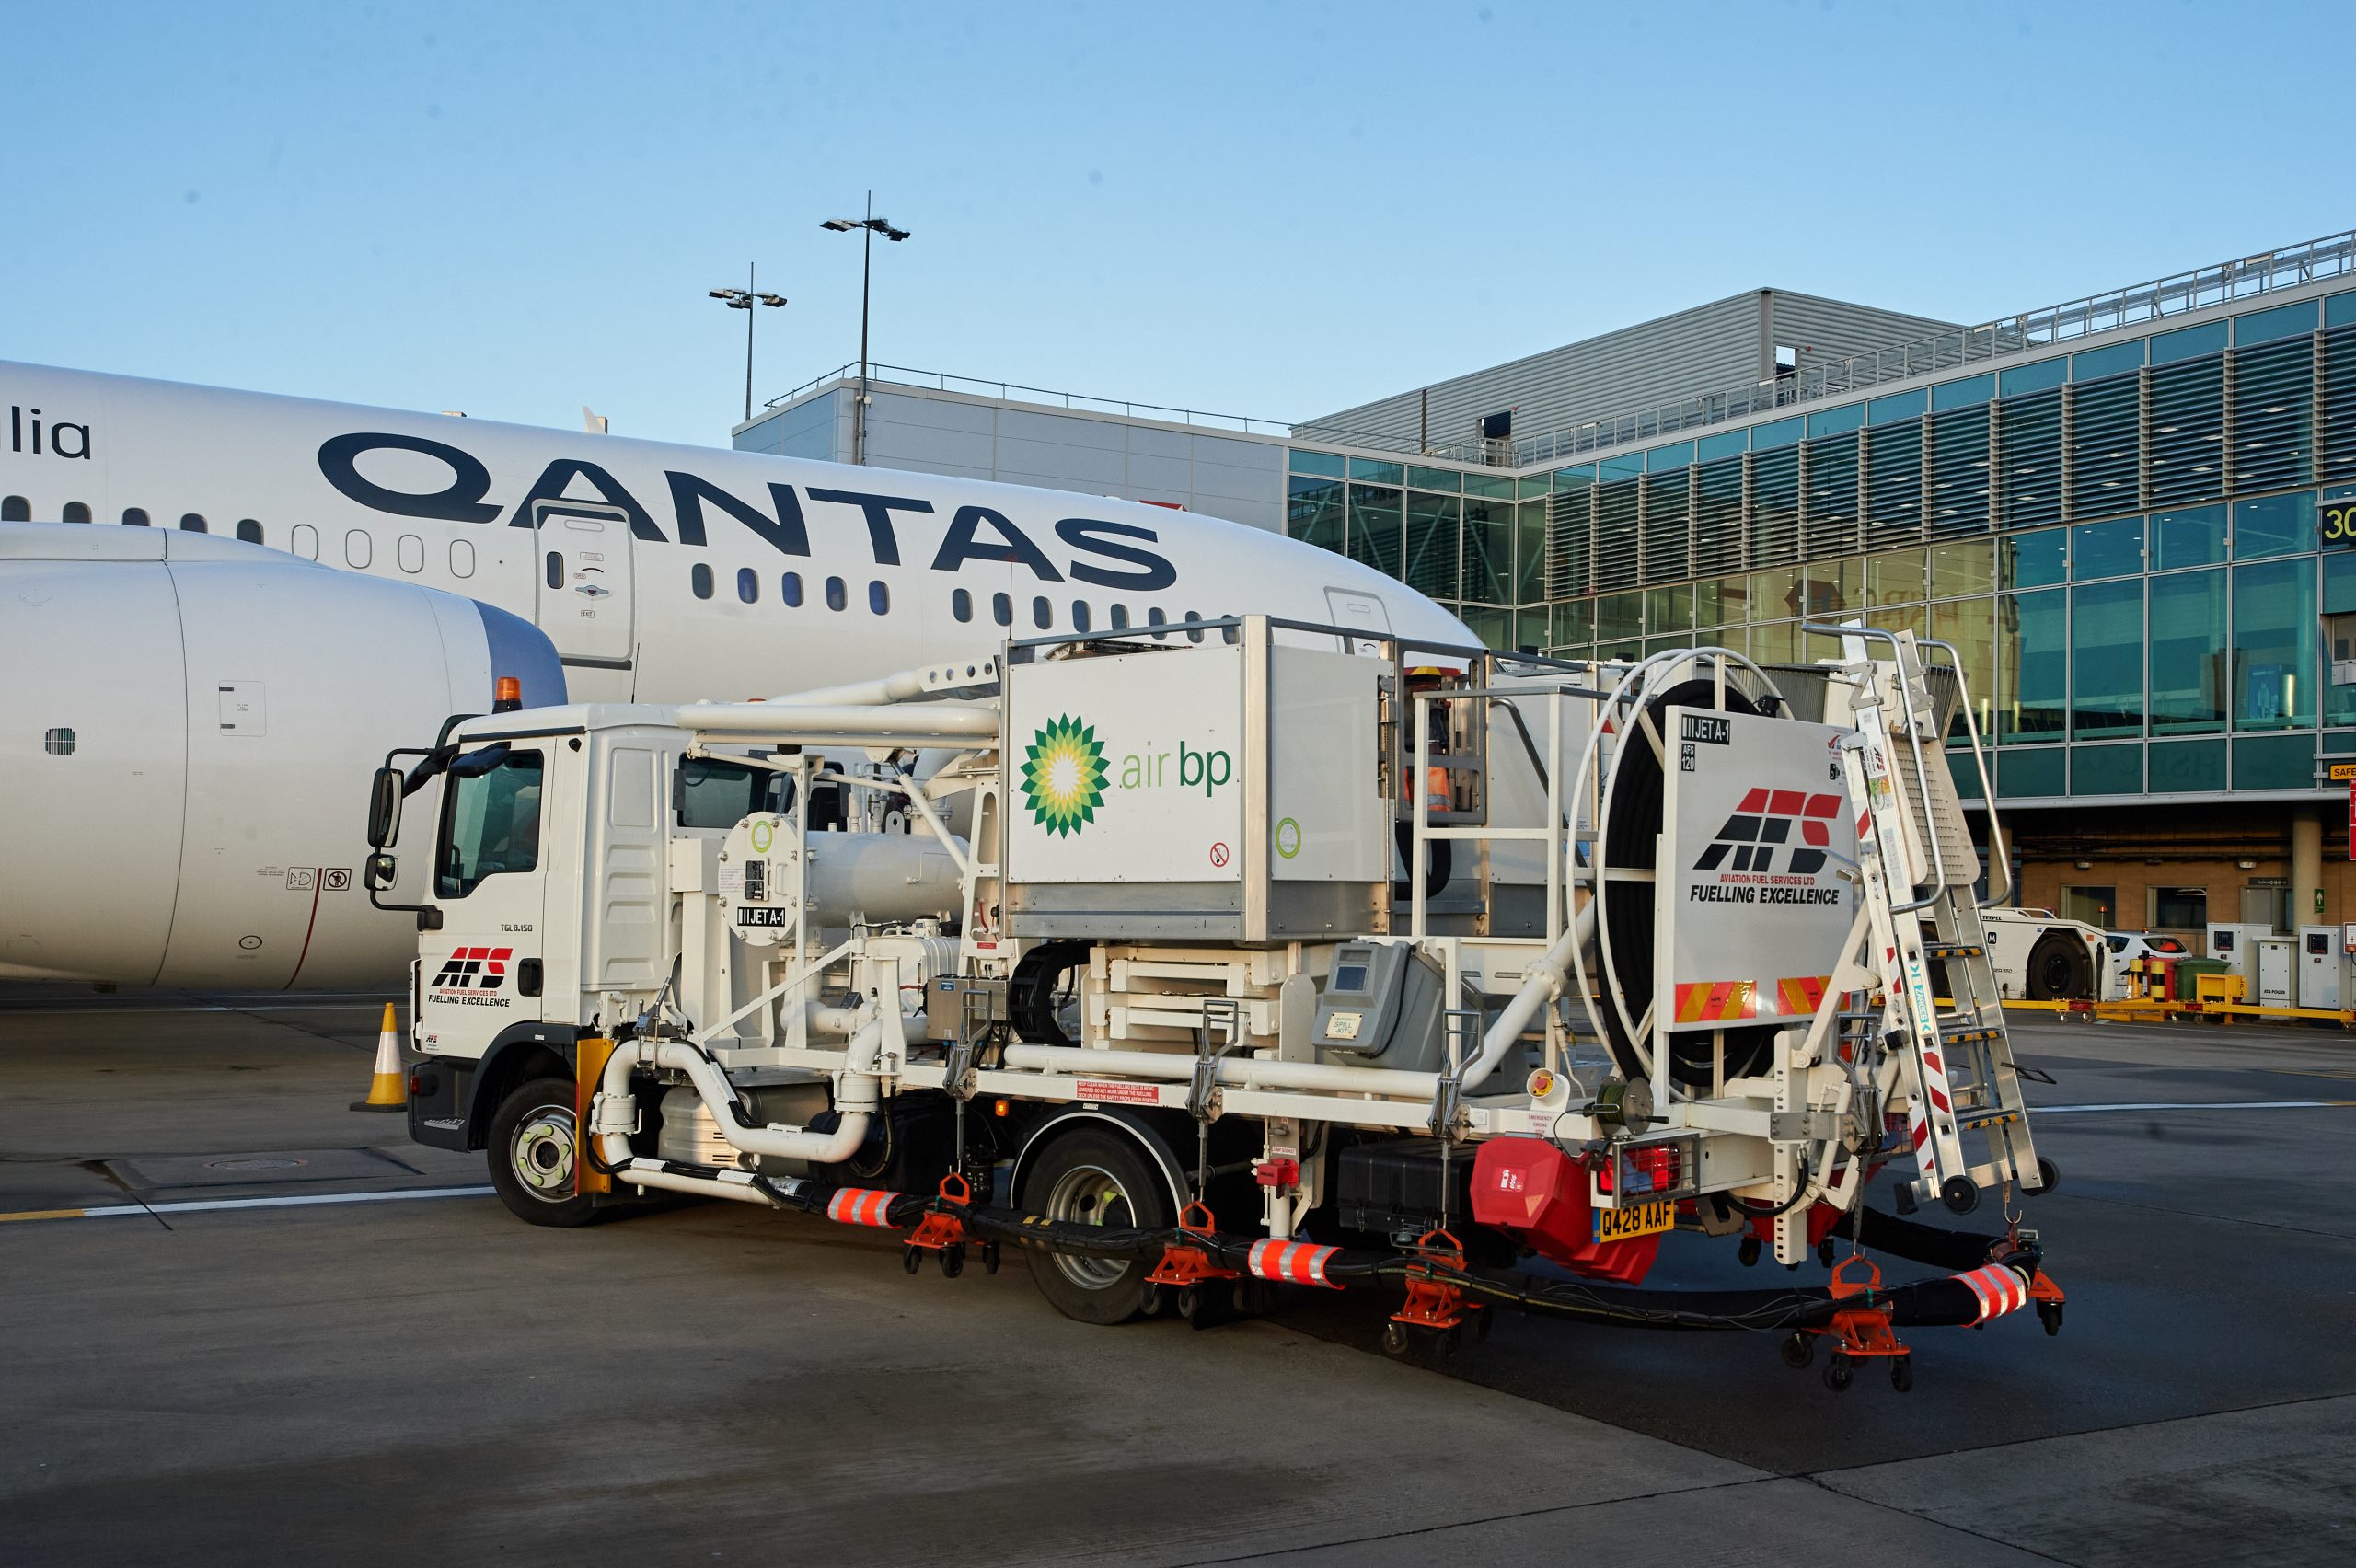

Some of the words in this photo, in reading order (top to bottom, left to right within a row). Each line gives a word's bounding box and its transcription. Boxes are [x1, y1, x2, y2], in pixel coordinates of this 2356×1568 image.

[318, 432, 1177, 592] QANTAS
[1695, 719, 1714, 739] JET
[1715, 721, 1729, 742] A-1
[1683, 745, 1694, 755] AFS
[1122, 741, 1171, 790] air
[1180, 741, 1230, 797] bp
[1682, 756, 1694, 770] 120
[2334, 768, 2356, 777] SAFE
[1692, 787, 1842, 874] AFS
[1720, 874, 1750, 883] AVIATION
[1751, 875, 1769, 884] FUEL
[1770, 875, 1801, 885] SERVICES
[1803, 877, 1815, 885] LTD
[1691, 885, 1755, 903] FUELLING
[1760, 888, 1839, 905] EXCELLENCE
[750, 909, 768, 924] JET
[769, 909, 784, 925] A-1
[431, 947, 514, 988] AFS
[429, 995, 459, 1004] FUELLING
[462, 997, 510, 1007] EXCELLENCE
[1915, 988, 1927, 1020] ZARGES
[1603, 1206, 1640, 1236] Q428
[1646, 1201, 1671, 1228] AAF
